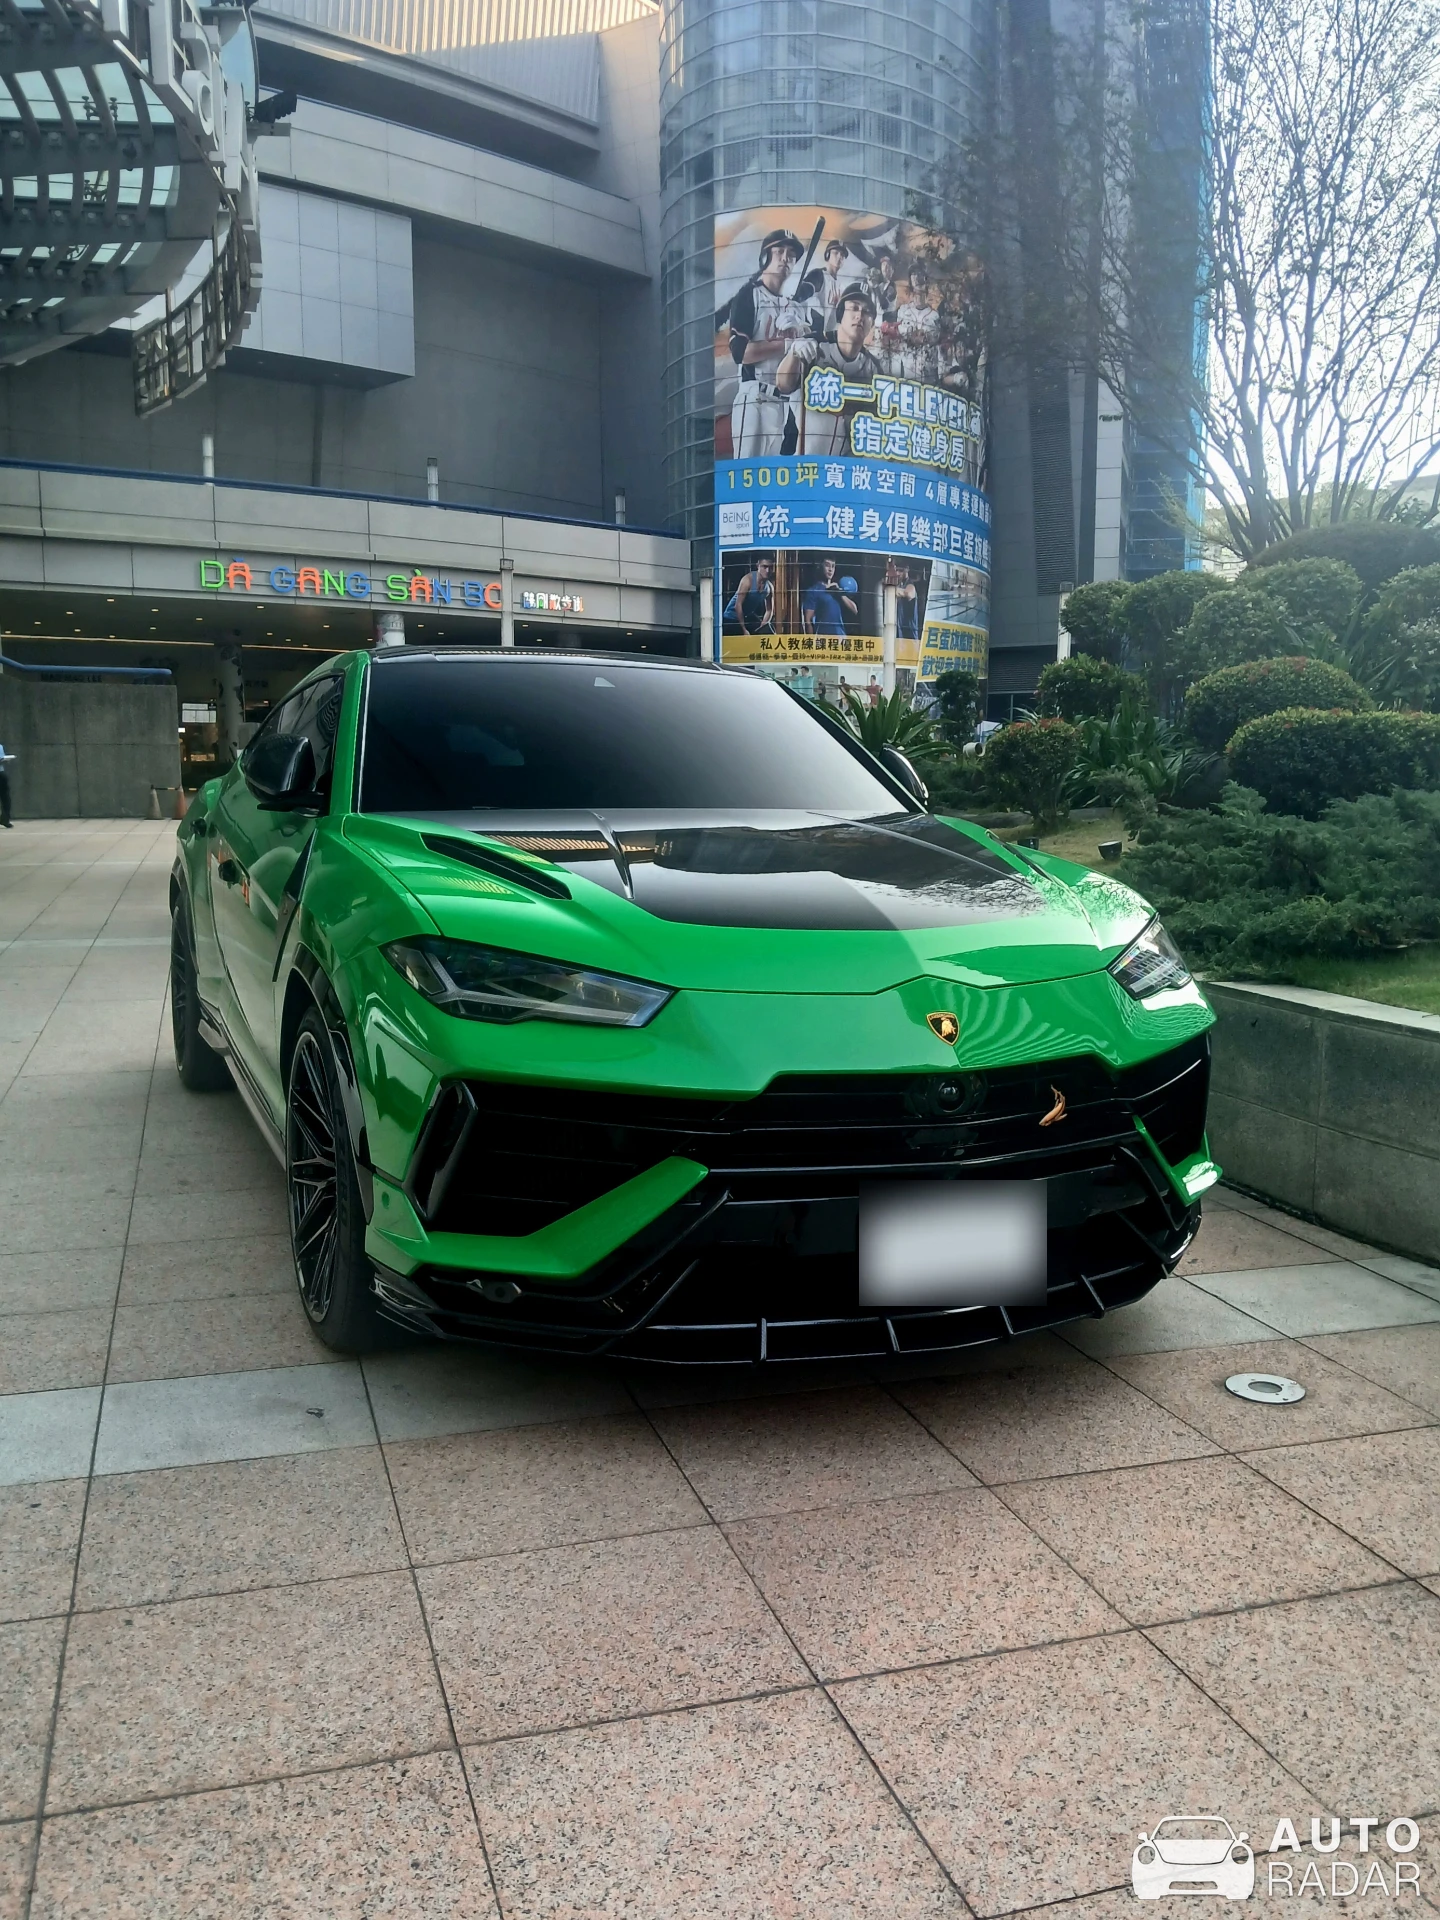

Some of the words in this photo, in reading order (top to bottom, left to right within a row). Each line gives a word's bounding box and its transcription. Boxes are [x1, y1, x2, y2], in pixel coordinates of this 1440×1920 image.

[855, 416, 965, 469] 指定健身房
[269, 566, 370, 599] GANG
[760, 637, 875, 652] 私人教練課程優惠中
